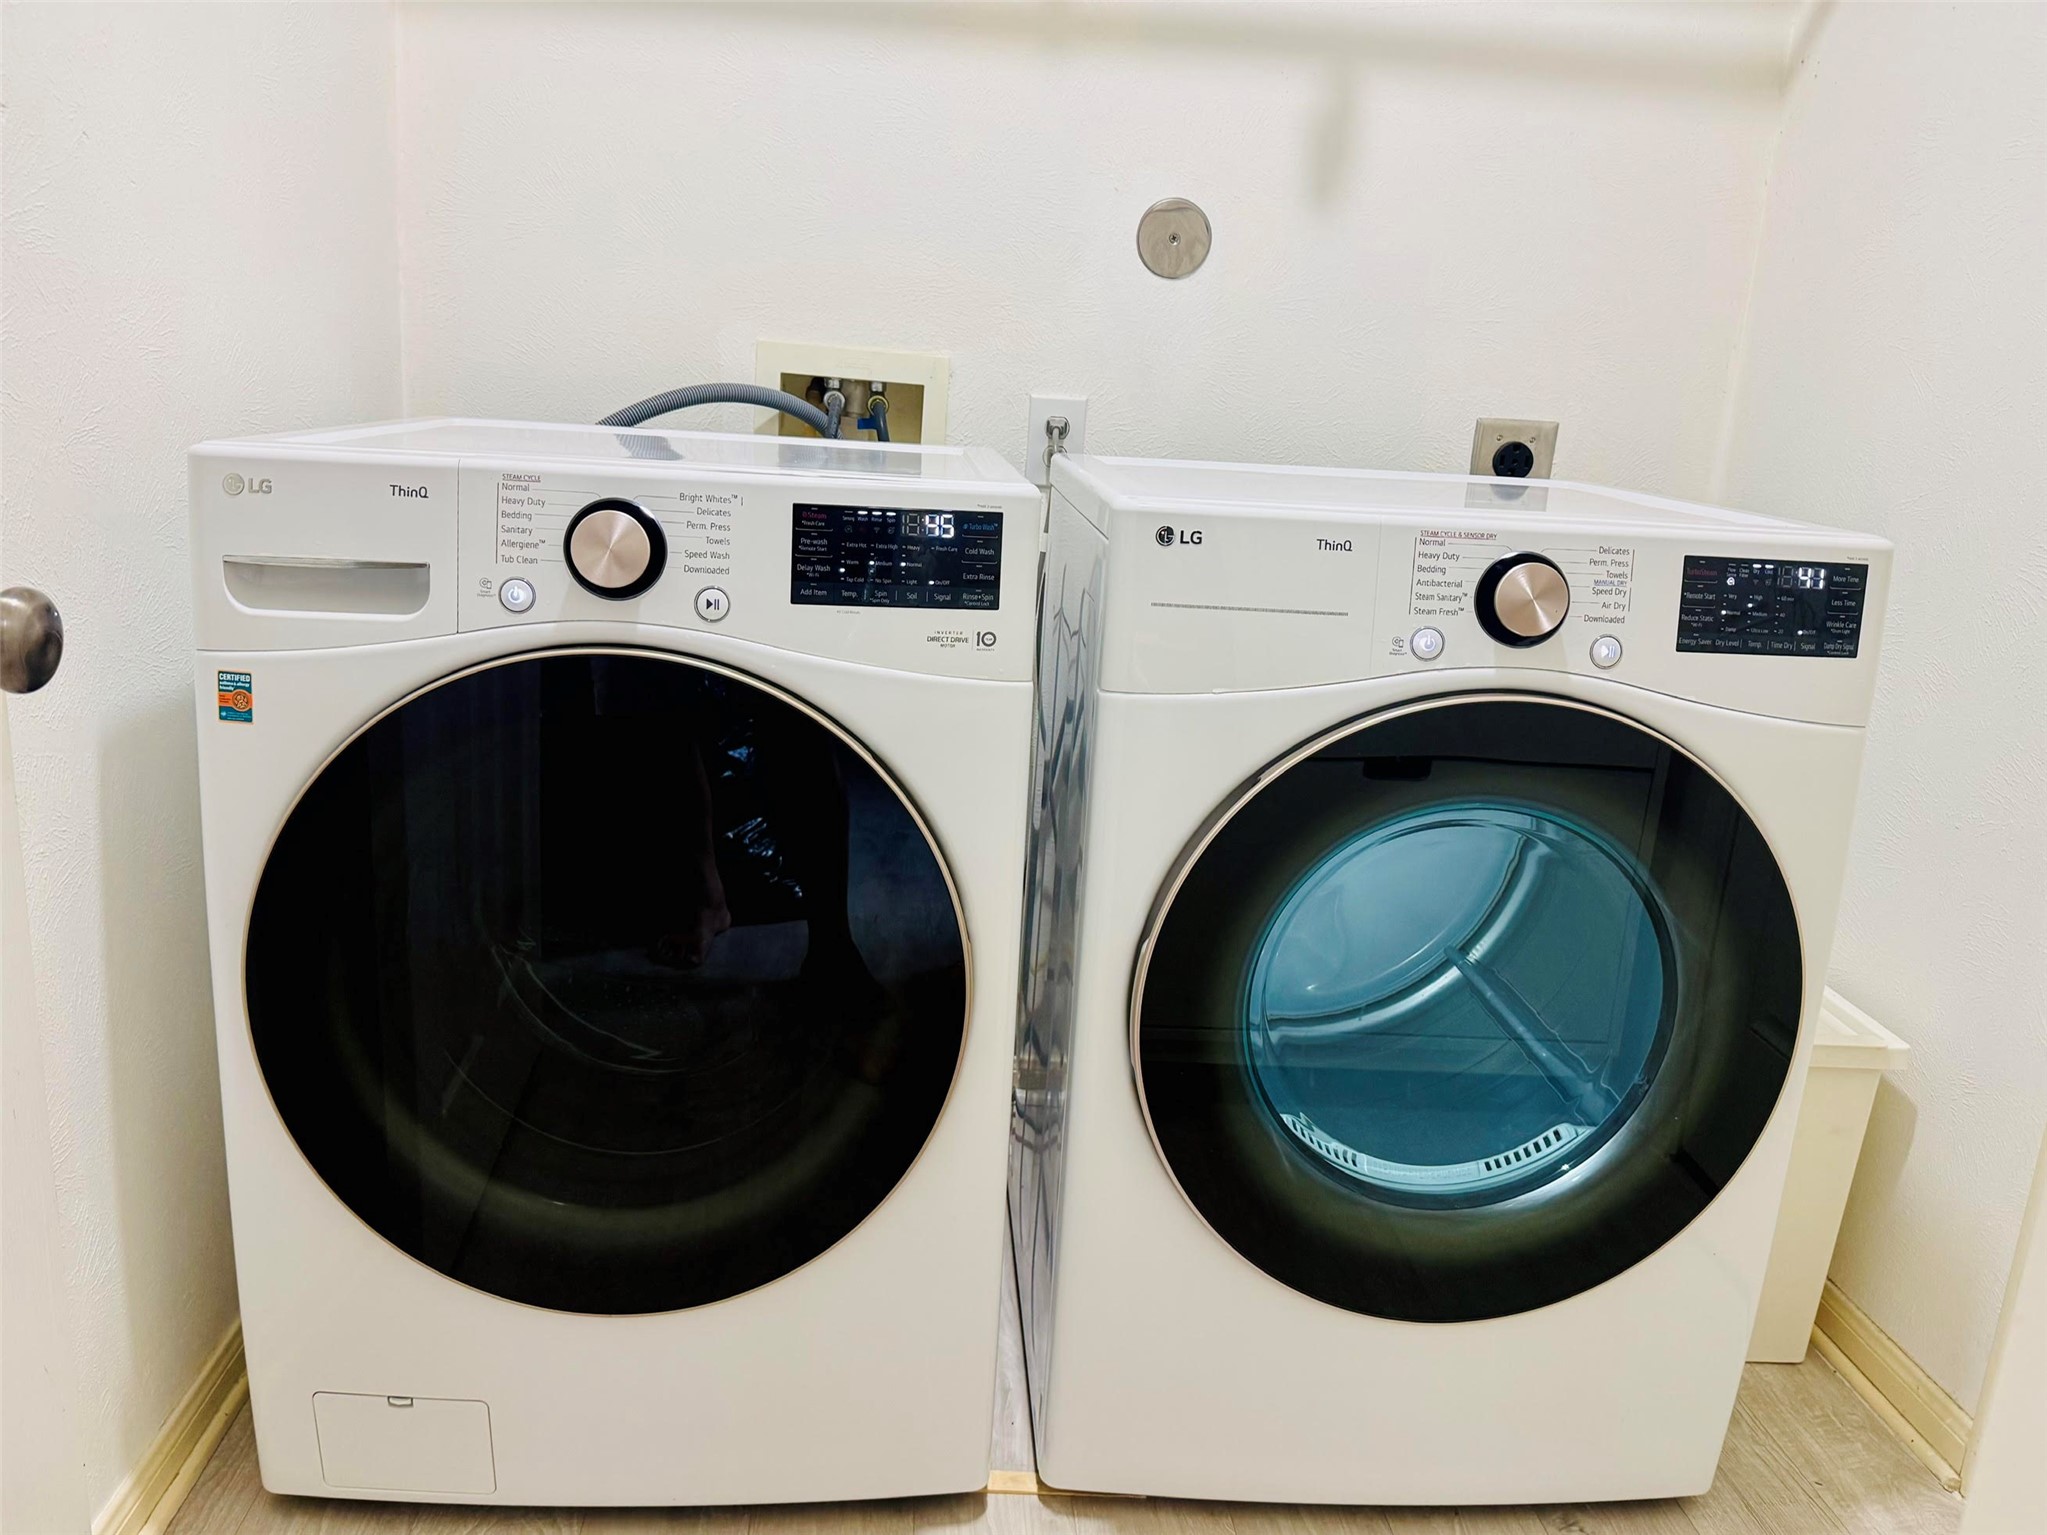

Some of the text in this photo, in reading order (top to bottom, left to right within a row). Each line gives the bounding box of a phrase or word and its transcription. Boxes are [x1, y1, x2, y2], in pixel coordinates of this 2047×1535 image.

[248, 478, 272, 494] LG
[502, 483, 530, 492] Normal
[390, 485, 429, 498] ThinQ
[502, 496, 546, 508] Heavy Duty
[680, 493, 703, 503] Bright
[502, 510, 532, 522] Bedding
[697, 507, 731, 517] Delicates
[501, 525, 532, 536] Sanitary
[686, 521, 731, 531] Perm. Press
[706, 536, 730, 545] Towels
[1179, 530, 1202, 544] LG
[1419, 538, 1445, 546] Normal
[1317, 539, 1352, 552] ThinQ
[1599, 546, 1630, 555] Delicates
[501, 555, 538, 564] Tub Clean
[685, 550, 730, 560] Speed Wash
[1418, 551, 1460, 561] Heavy Duty
[1589, 558, 1629, 567] Perm. Press
[684, 565, 730, 575] Downloaded
[1417, 565, 1446, 575] Bedding
[1606, 570, 1628, 579] Towels
[1416, 579, 1462, 588] Antibacterial
[1415, 592, 1435, 600] Steam
[1592, 587, 1627, 598] Speed Dry
[1414, 606, 1437, 615] Steam
[1614, 602, 1626, 611] Dry
[1584, 615, 1625, 624] Downloaded
[976, 631, 997, 647] 10
[1679, 638, 1697, 646] Energy
[1784, 642, 1793, 650] Dry
[220, 673, 250, 682] CERTIFIED
